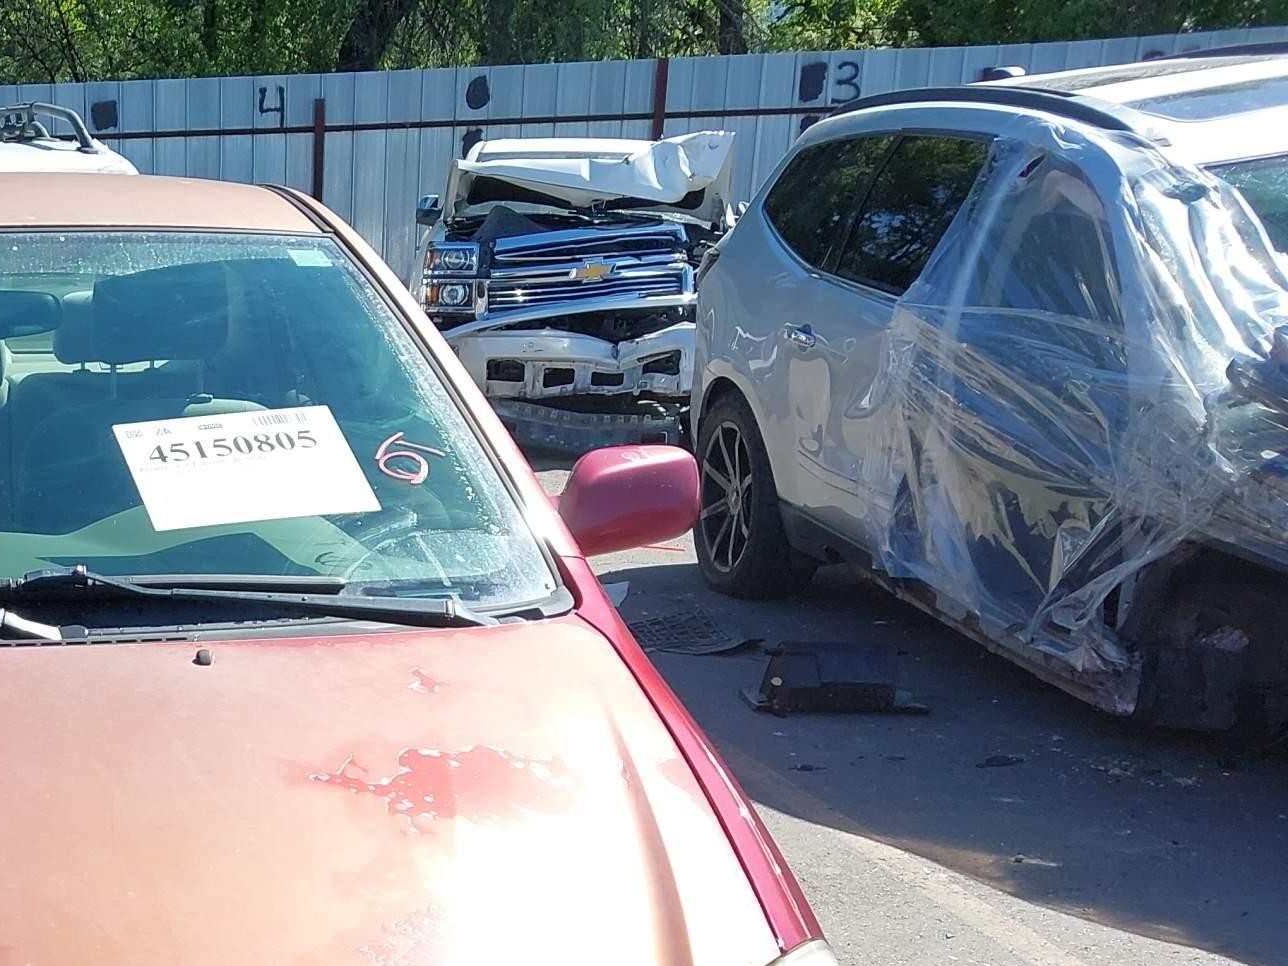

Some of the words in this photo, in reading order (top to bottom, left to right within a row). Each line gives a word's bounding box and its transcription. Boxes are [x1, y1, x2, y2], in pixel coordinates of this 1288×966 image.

[831, 61, 861, 103] 3
[259, 86, 285, 127] 4
[148, 429, 318, 464] 45150805
